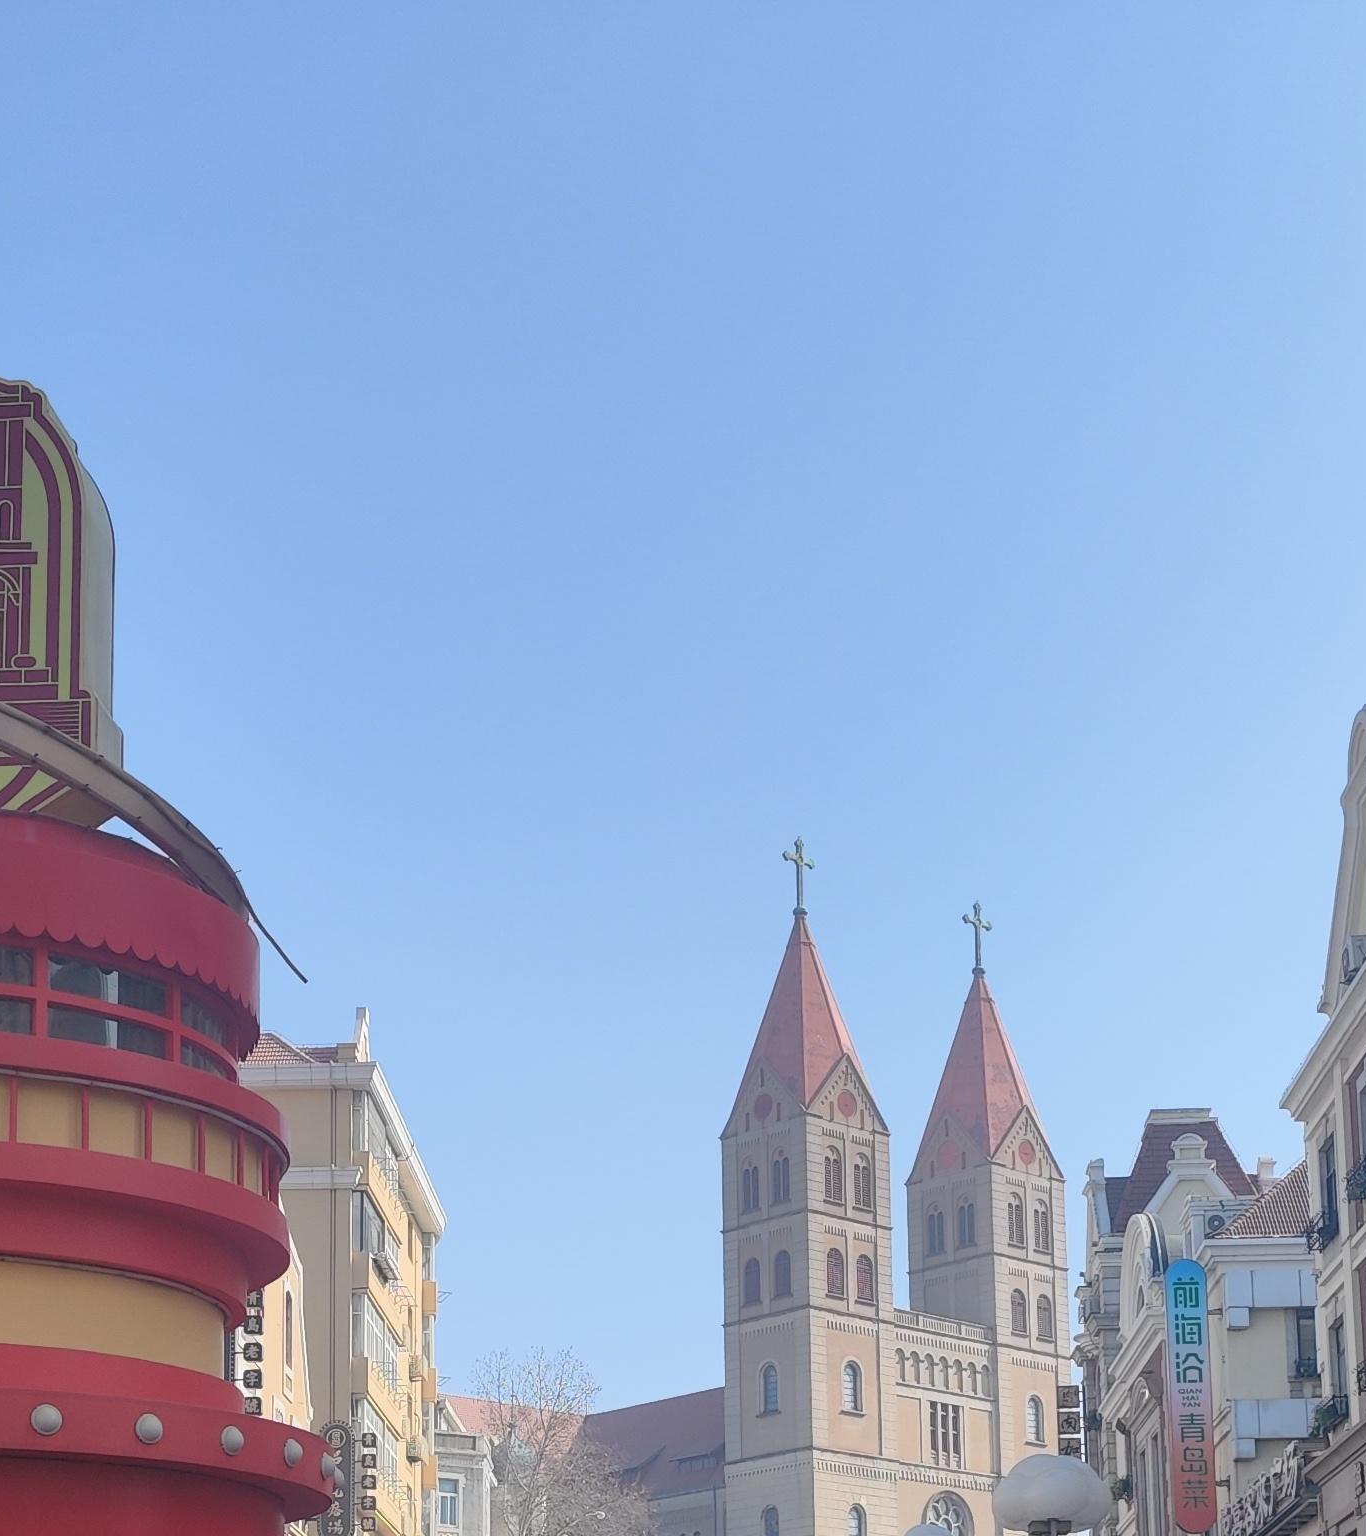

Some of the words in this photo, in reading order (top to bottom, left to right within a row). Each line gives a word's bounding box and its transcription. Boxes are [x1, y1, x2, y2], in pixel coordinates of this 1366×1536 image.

[1172, 1277, 1205, 1384] 前海沿
[1178, 1413, 1209, 1509] 青岛菜
